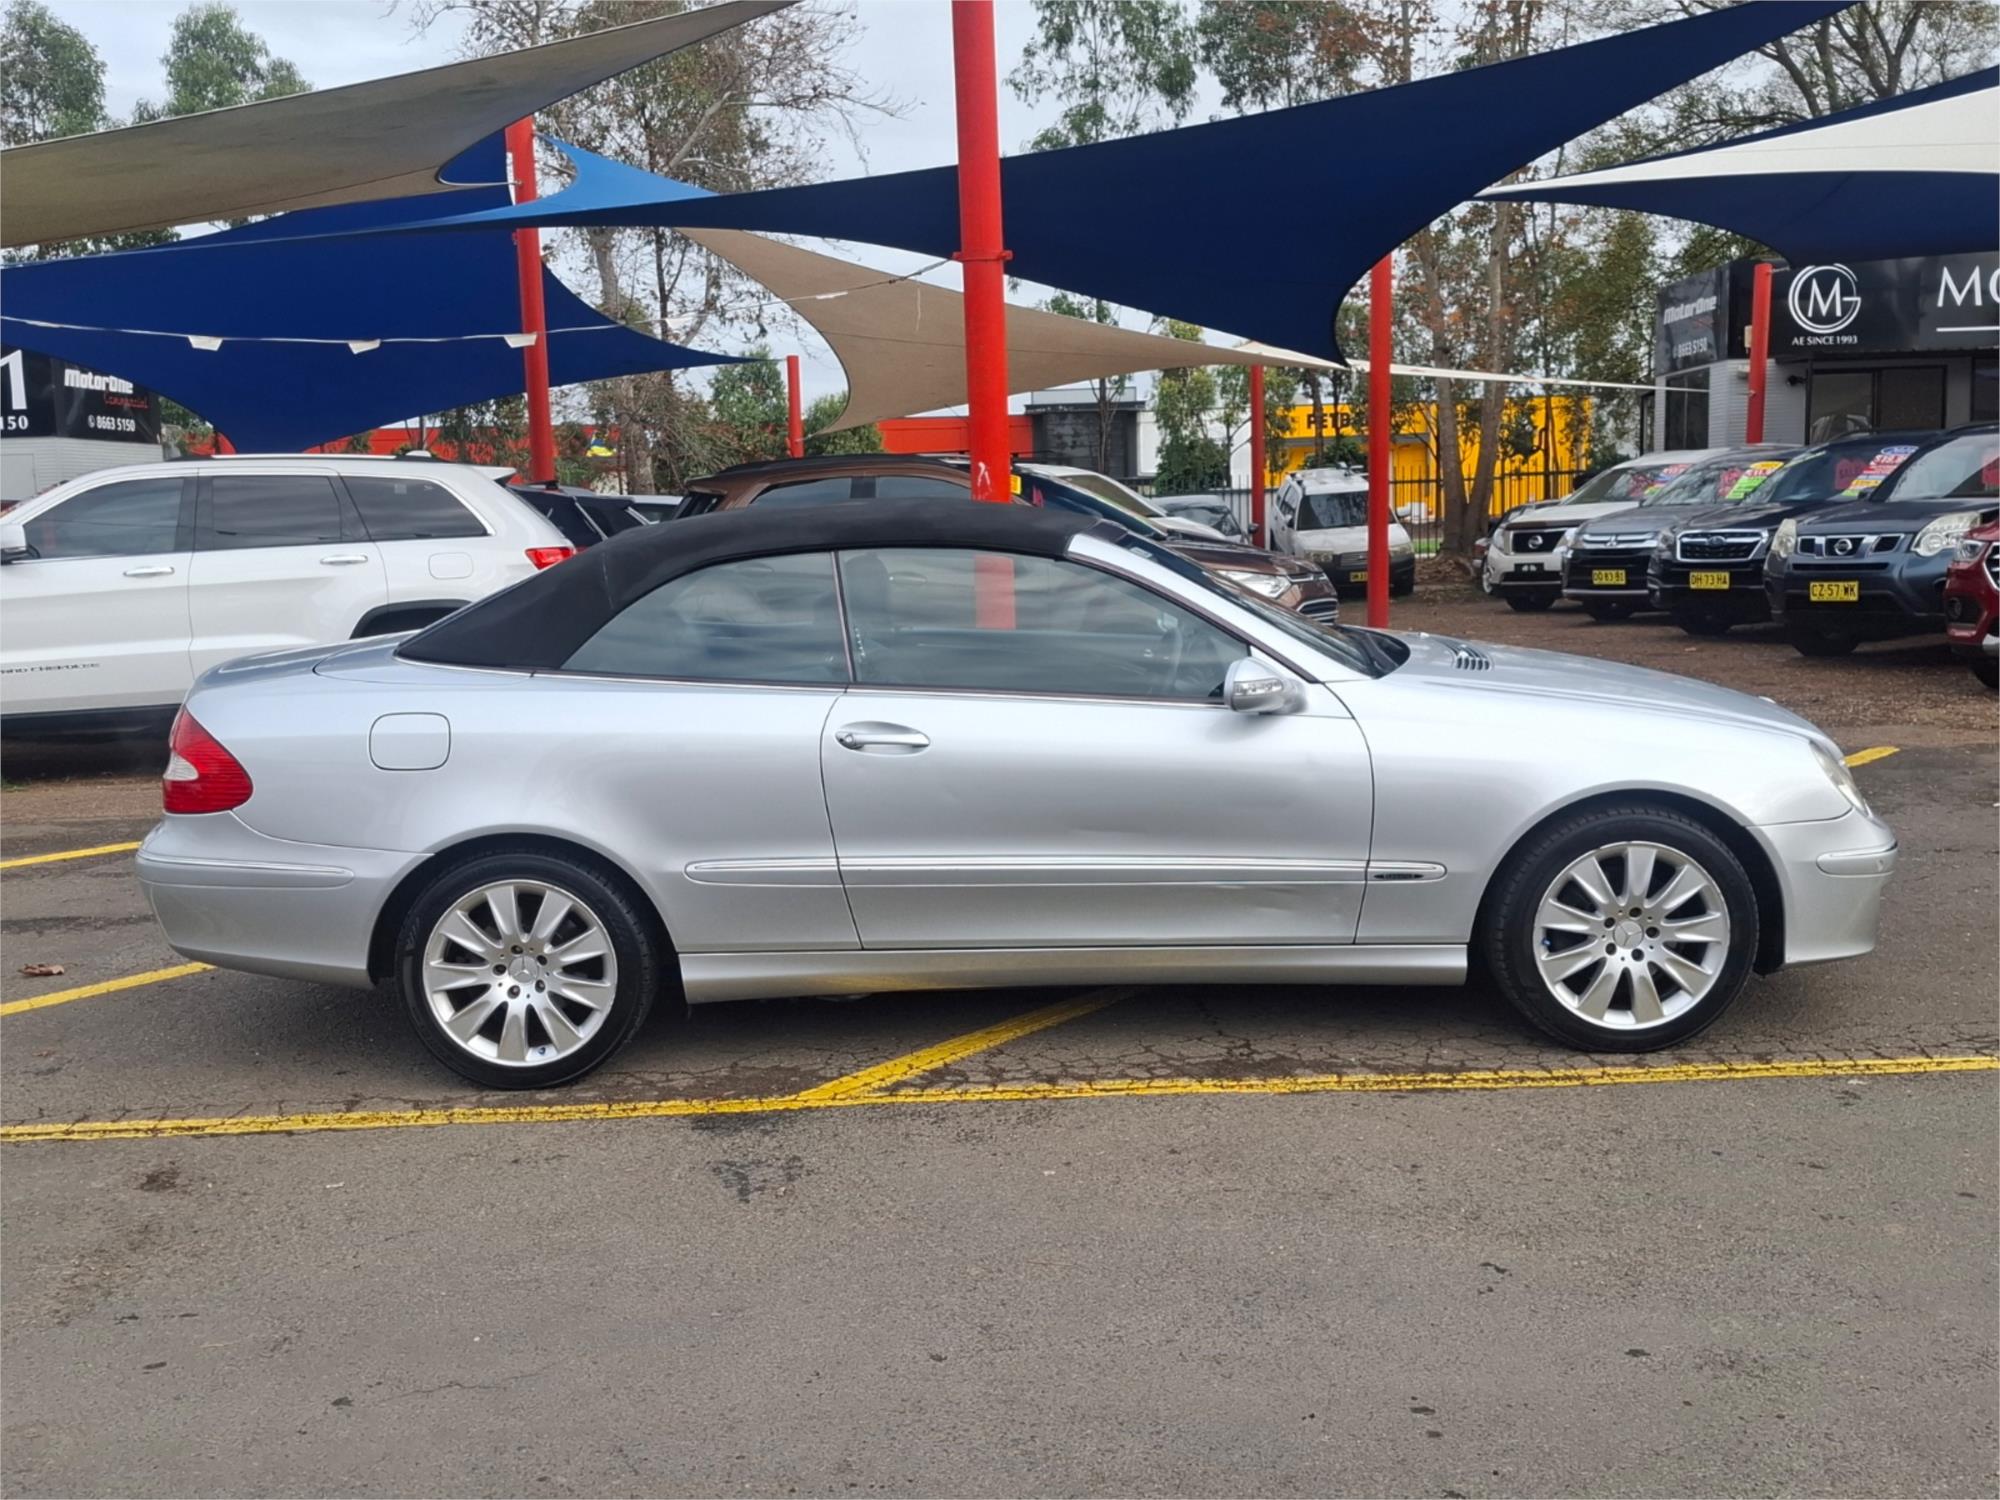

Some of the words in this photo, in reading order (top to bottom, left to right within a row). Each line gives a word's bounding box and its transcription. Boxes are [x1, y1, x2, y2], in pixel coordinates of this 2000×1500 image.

[1937, 265, 2000, 308] M
[1792, 336, 1805, 346] AE
[1807, 335, 1835, 345] SINCE
[116, 417, 136, 432] 5150
